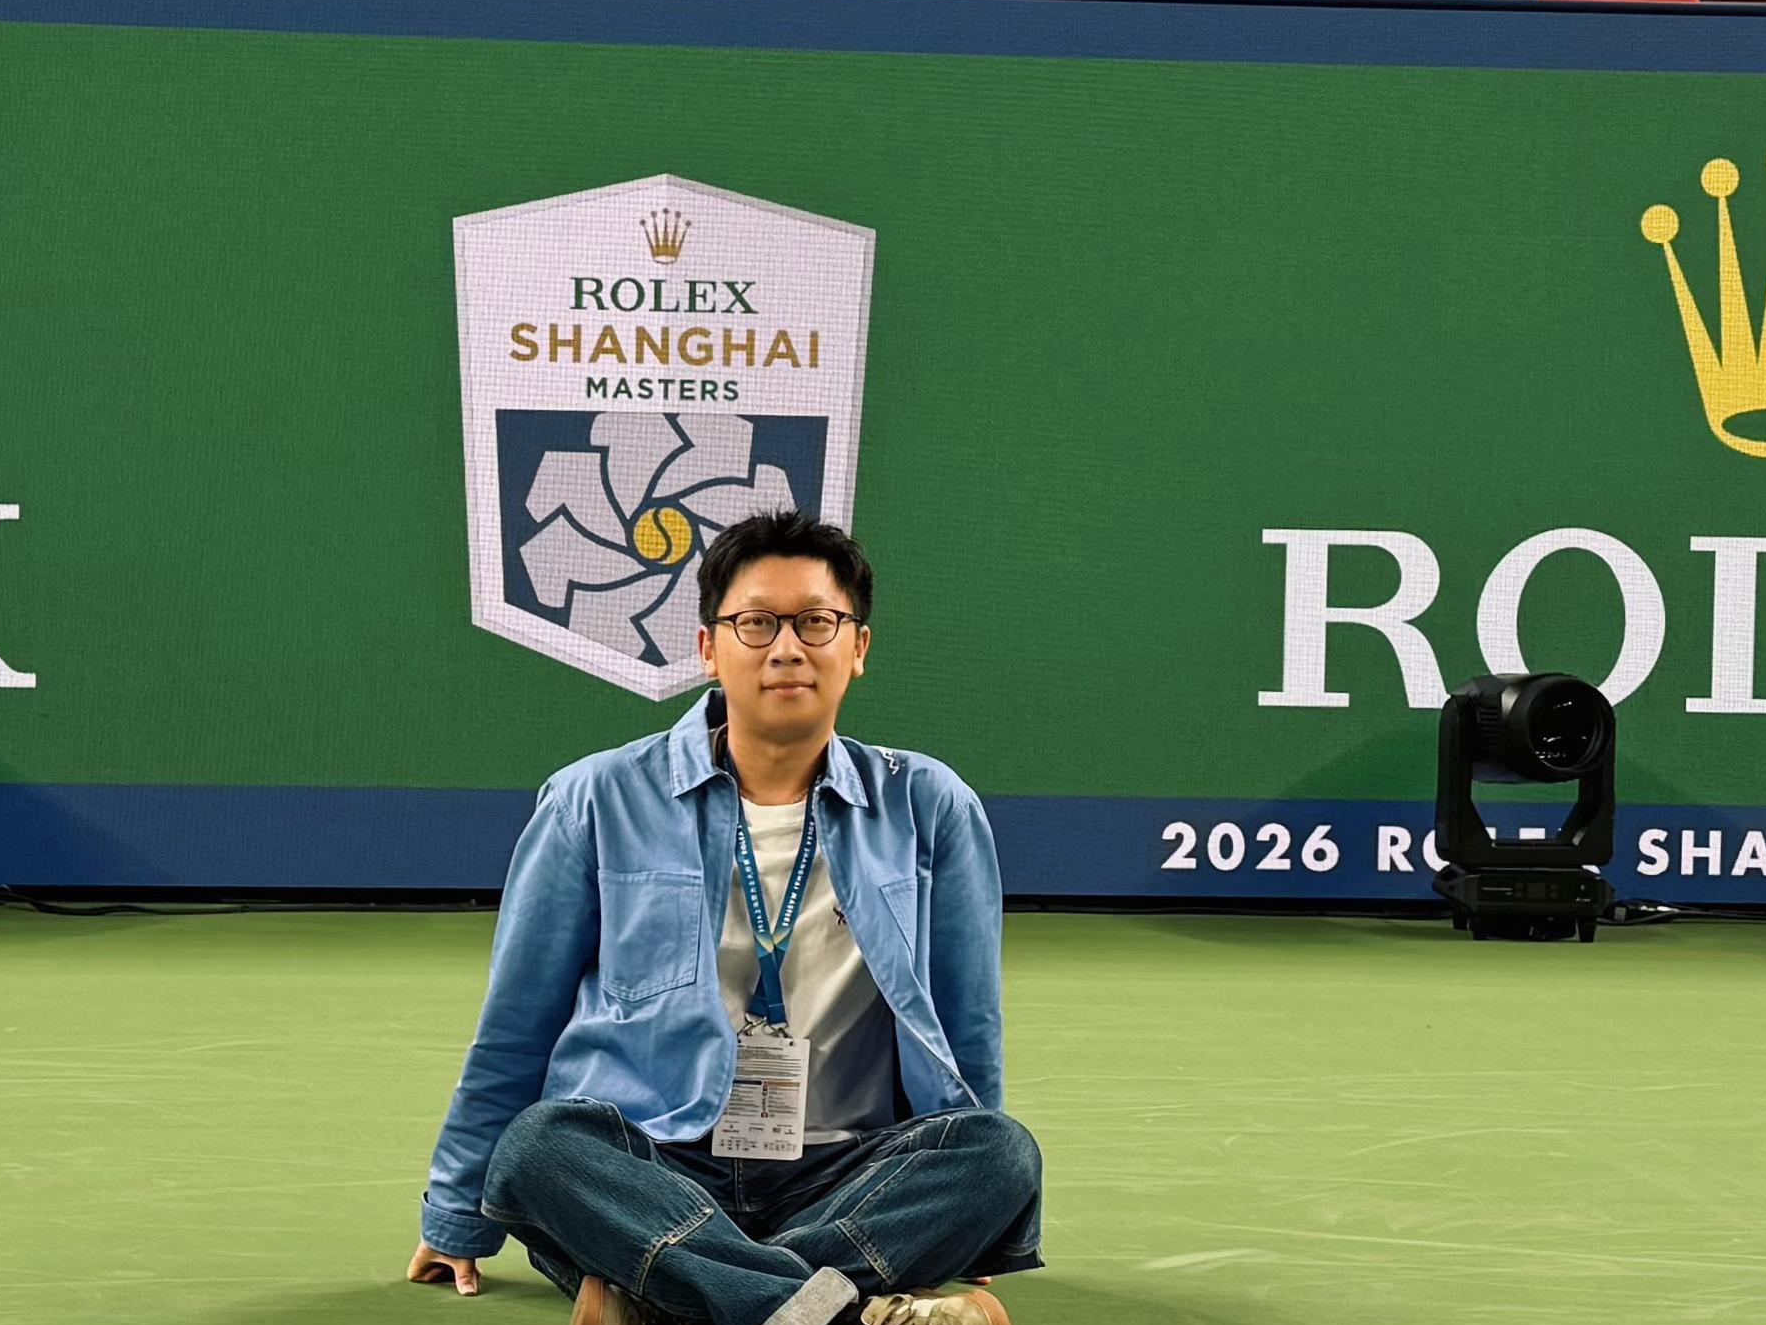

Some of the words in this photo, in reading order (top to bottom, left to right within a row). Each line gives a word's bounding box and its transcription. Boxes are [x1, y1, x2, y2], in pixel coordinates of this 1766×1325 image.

[569, 276, 760, 315] ROLEX
[509, 323, 819, 369] SHANGHAI
[585, 375, 740, 402] MASTERS
[1160, 821, 1340, 872] 2026
